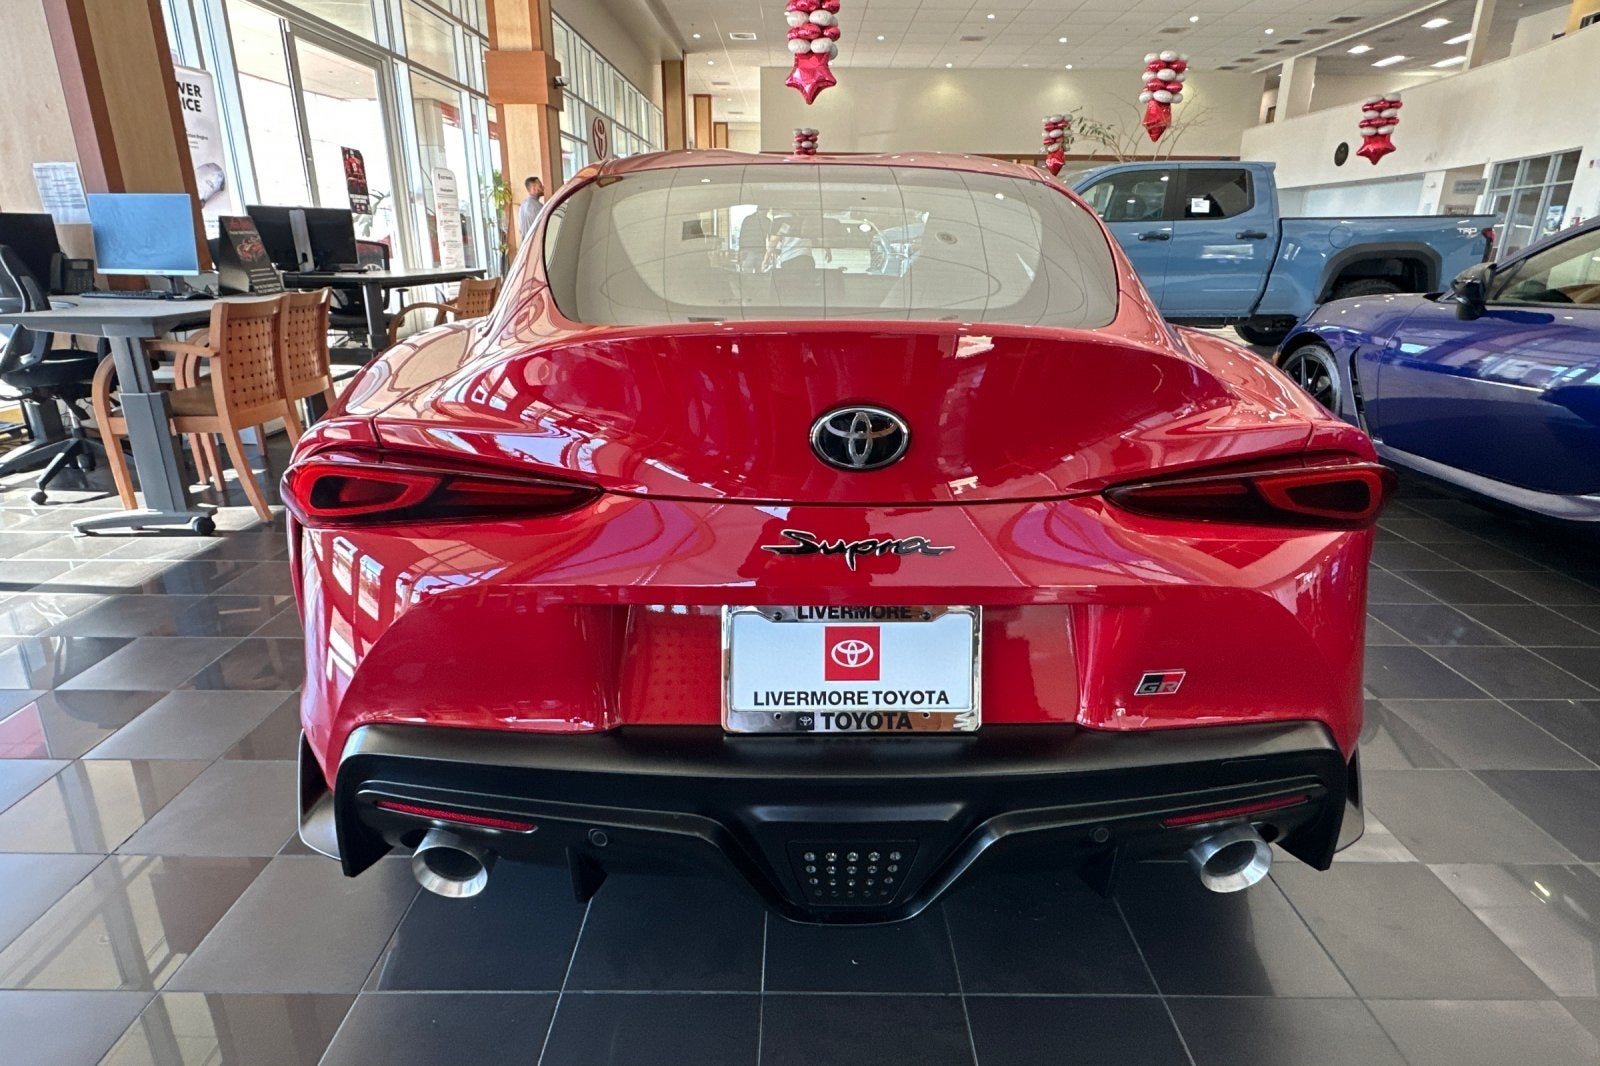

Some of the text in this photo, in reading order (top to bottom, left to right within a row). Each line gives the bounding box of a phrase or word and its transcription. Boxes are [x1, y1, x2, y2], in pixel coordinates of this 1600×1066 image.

[181, 97, 202, 112] ICE
[761, 529, 955, 571] Supra
[797, 605, 912, 619] LIVERMORE
[753, 690, 949, 706] LIVERMORE TOYOTA
[820, 712, 912, 730] TOYOTA
